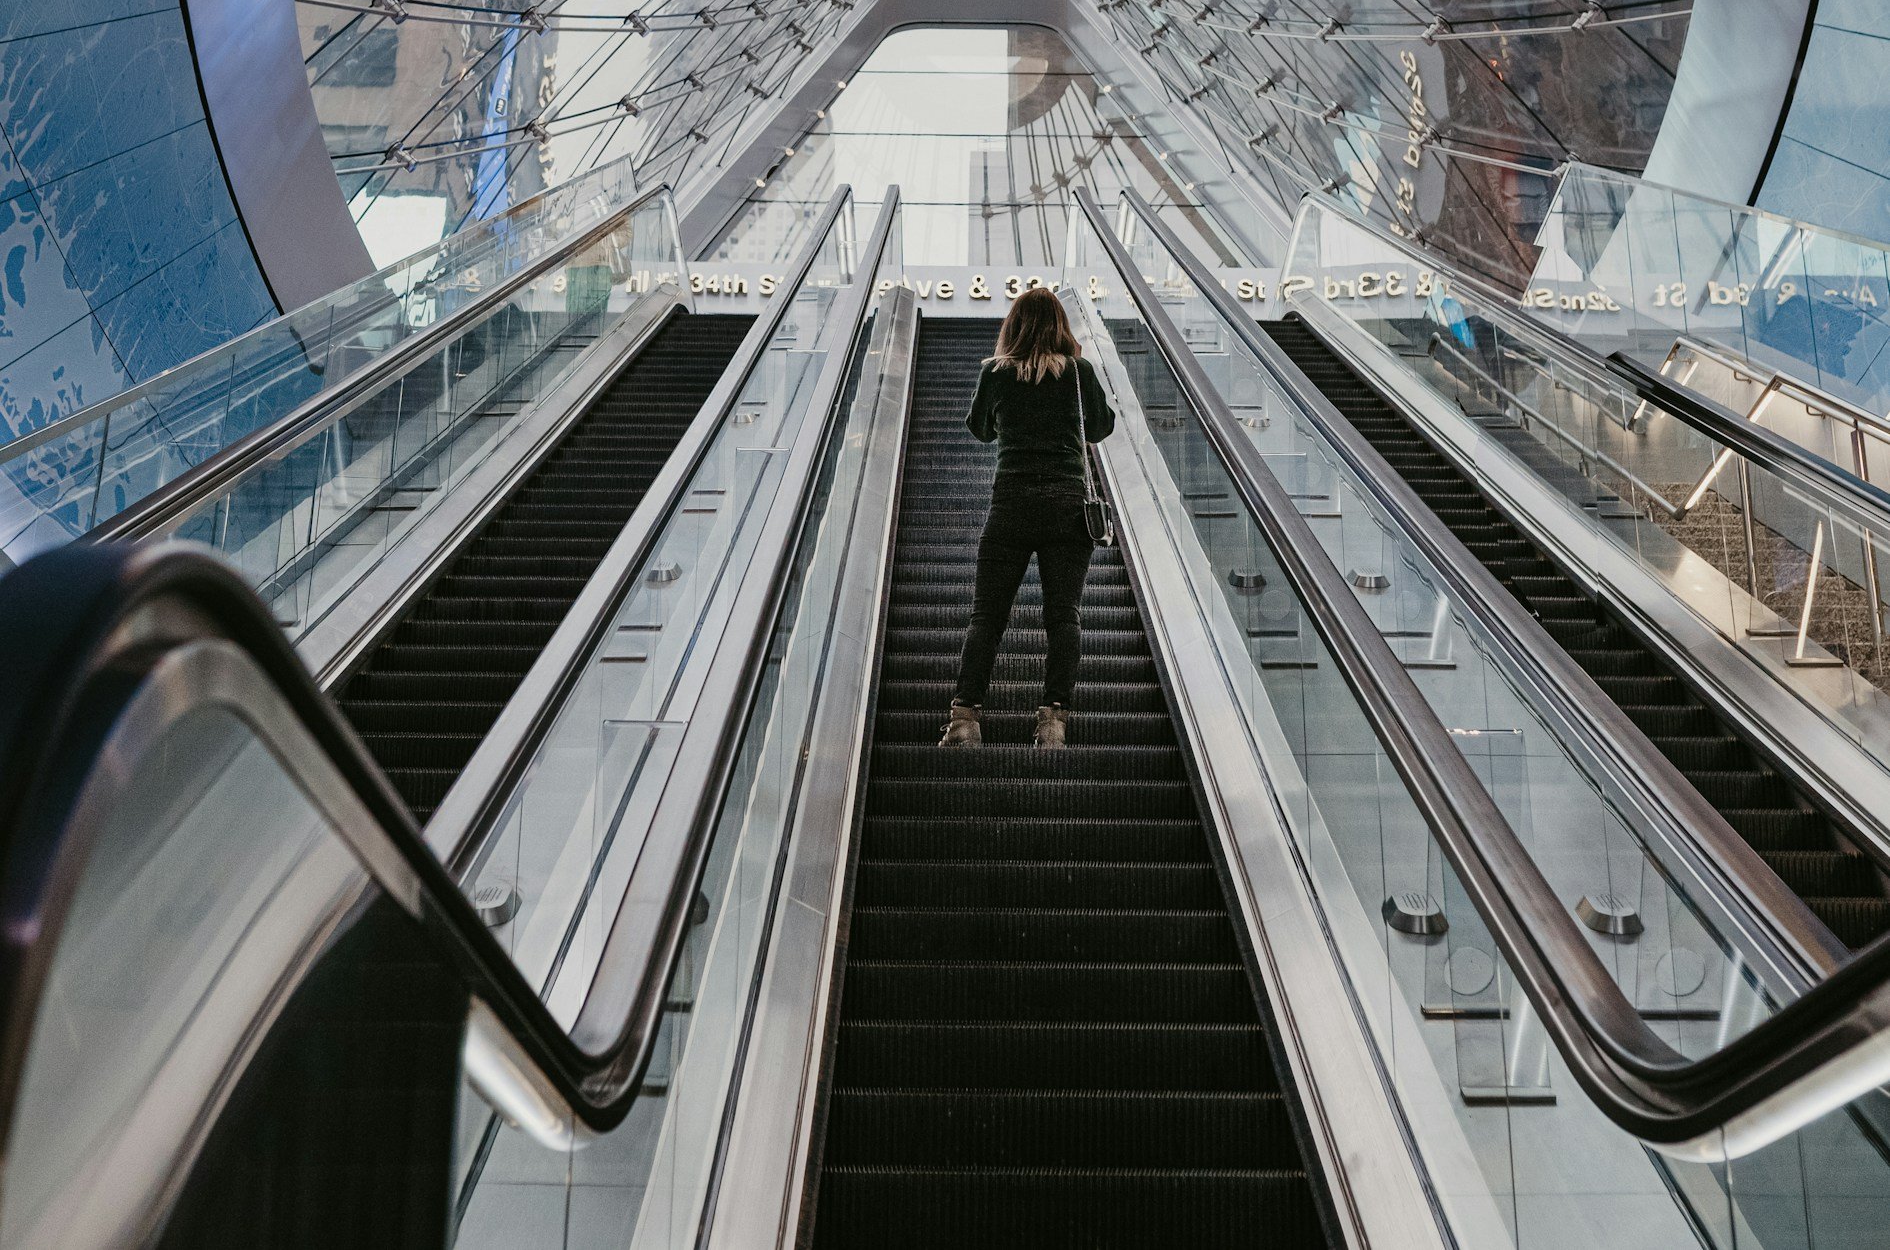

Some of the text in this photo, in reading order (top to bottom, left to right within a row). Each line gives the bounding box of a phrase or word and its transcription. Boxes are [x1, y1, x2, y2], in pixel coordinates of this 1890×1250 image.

[690, 272, 748, 295] 34th
[758, 273, 784, 295] S
[968, 275, 991, 298] &
[1237, 279, 1267, 300] St
